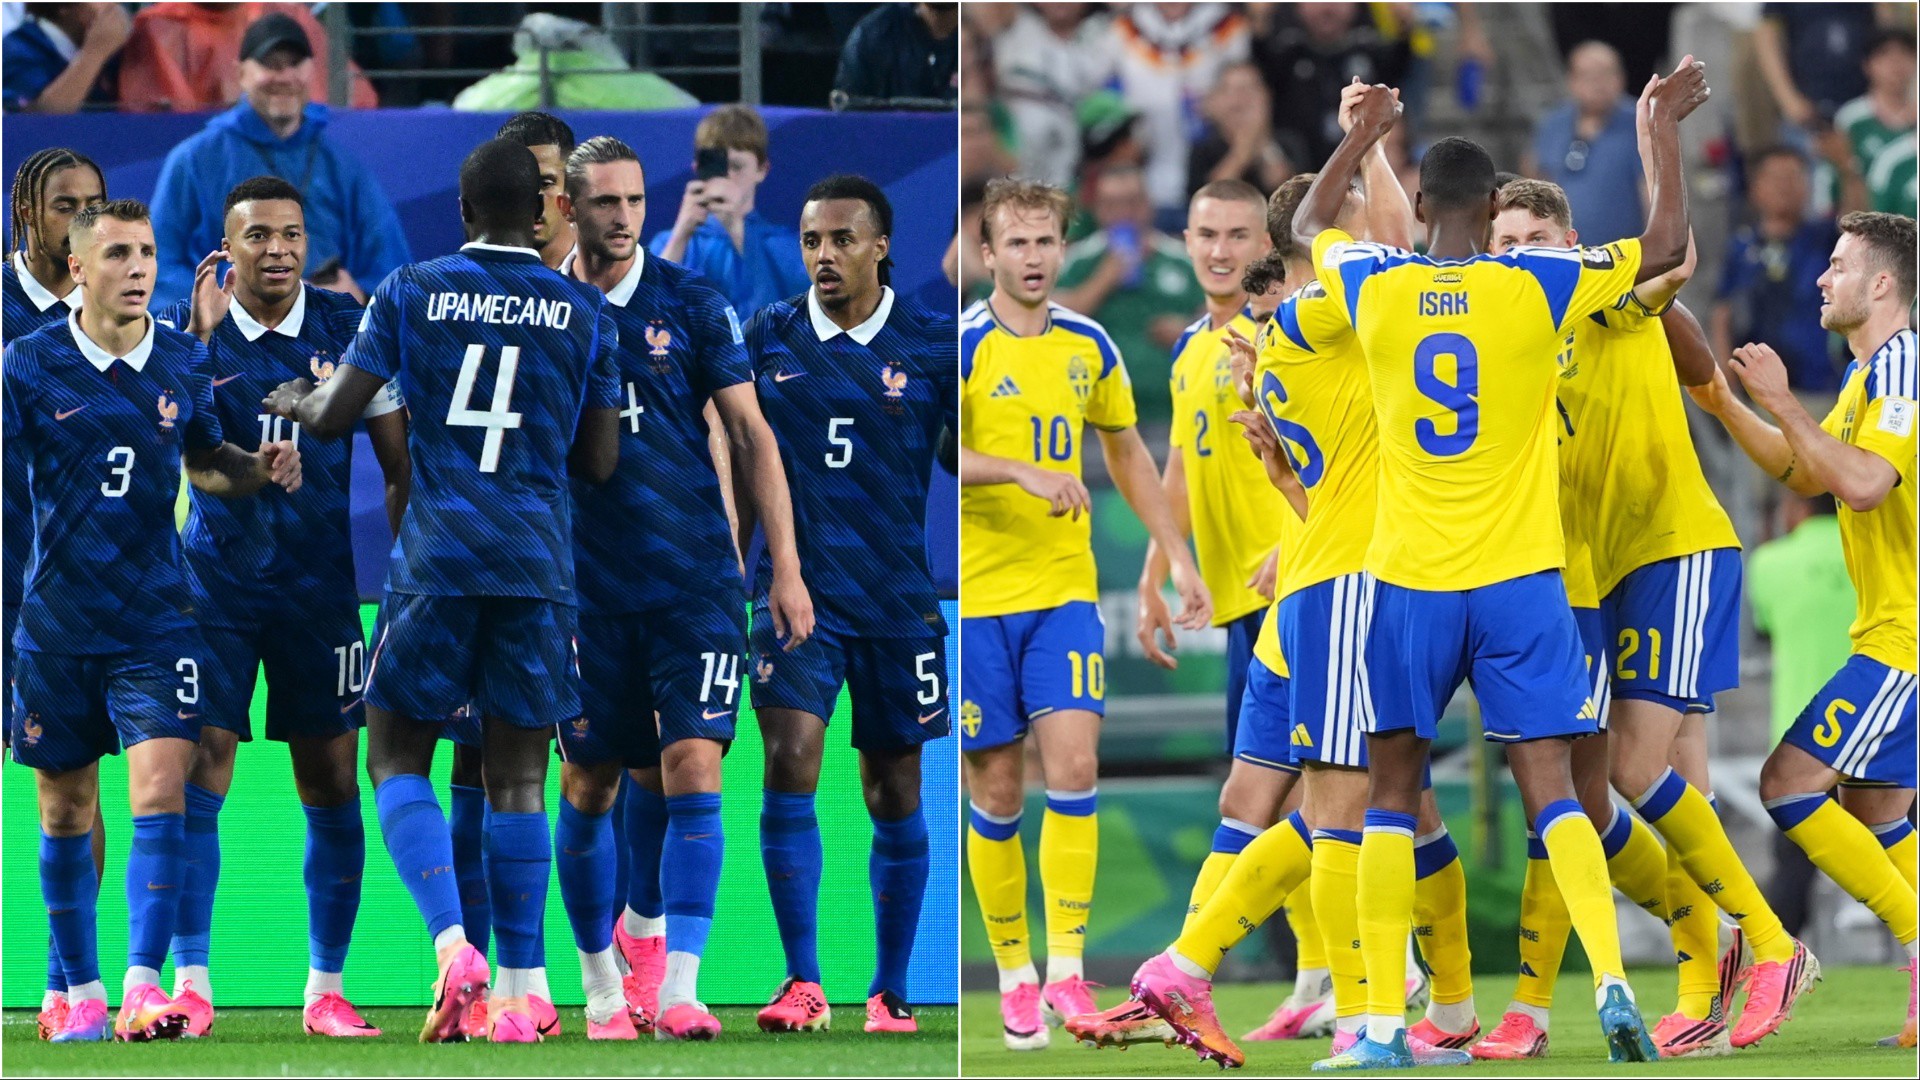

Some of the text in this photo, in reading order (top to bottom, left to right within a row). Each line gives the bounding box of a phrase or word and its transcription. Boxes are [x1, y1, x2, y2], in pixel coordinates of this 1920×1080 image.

[427, 292, 572, 331] UPAMECANO
[1419, 291, 1468, 316] ISAK
[446, 344, 523, 473] 4
[1413, 332, 1479, 457] 9
[824, 417, 855, 469] 5
[1031, 415, 1072, 462] 10
[1194, 410, 1212, 457] 2
[100, 445, 135, 498] 3
[334, 640, 365, 697] 10
[700, 652, 739, 705] 14
[915, 651, 940, 706] 5
[1068, 651, 1105, 700] 10
[1617, 627, 1662, 680] 21
[176, 657, 199, 705] 3
[1812, 698, 1857, 748] 5
